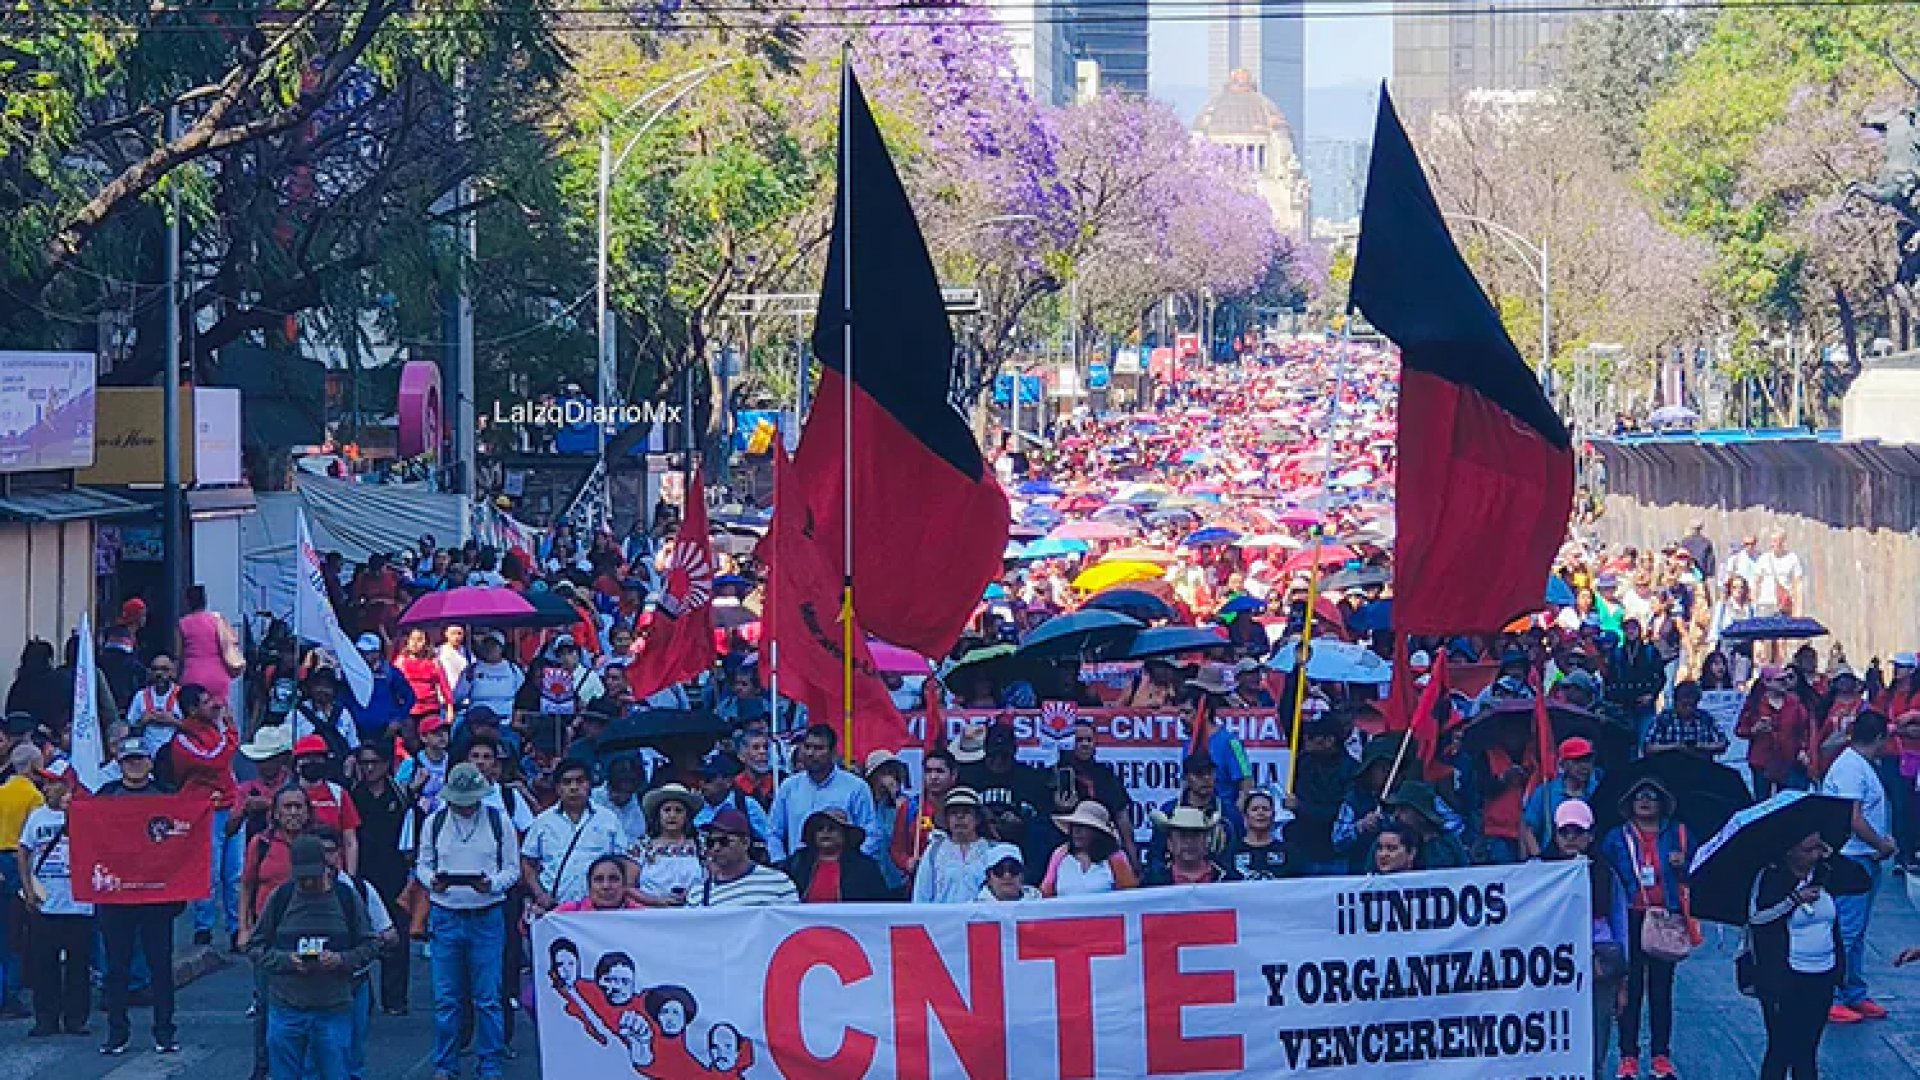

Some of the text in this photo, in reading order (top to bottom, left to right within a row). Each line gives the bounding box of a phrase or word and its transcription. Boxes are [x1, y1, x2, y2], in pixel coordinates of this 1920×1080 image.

[1336, 882, 1508, 935] ¡¡UNIDOS
[298, 936, 329, 955] CAT
[1261, 943, 1583, 1006] Y ORGANIZADOS,
[763, 908, 1245, 1080] CNTE
[1279, 1009, 1570, 1070] VENCEREMOS!!
